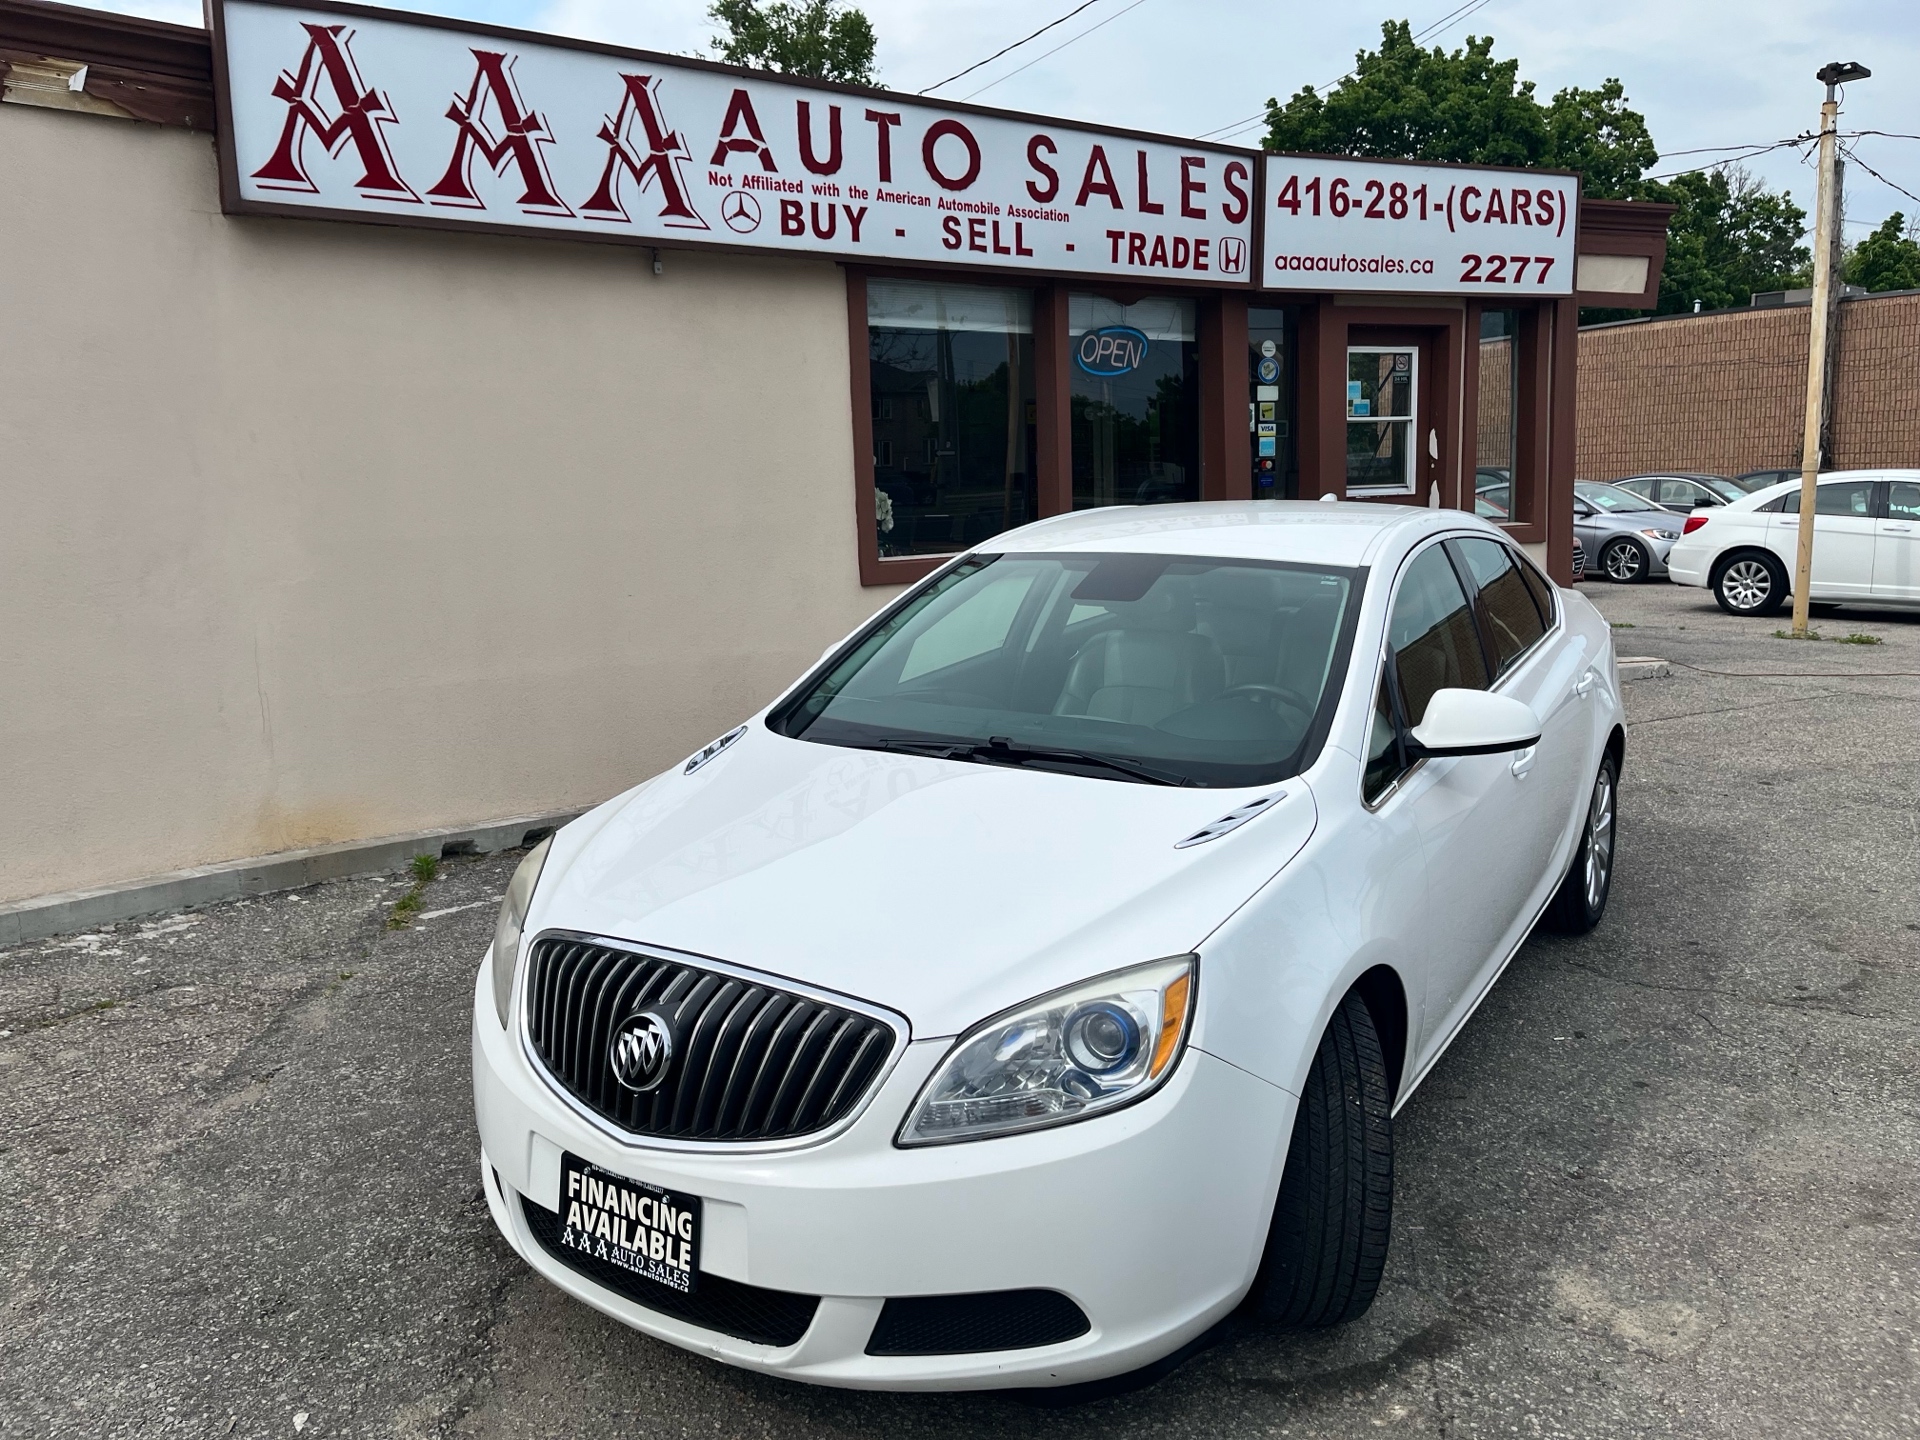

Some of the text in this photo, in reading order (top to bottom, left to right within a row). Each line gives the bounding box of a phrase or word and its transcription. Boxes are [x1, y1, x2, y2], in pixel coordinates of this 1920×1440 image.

[710, 89, 981, 192] AUTO
[1026, 134, 1249, 225] SALES
[708, 171, 1070, 223] Not Affiliated with the American Automobile Association
[1277, 175, 1566, 238] 416-281-(CARS)
[780, 199, 868, 242] BUY
[941, 215, 1033, 257] SELL
[1106, 230, 1210, 271] TRADE
[1275, 254, 1434, 274] aaaautosales.ca
[1459, 254, 1555, 284] 2277
[1081, 335, 1143, 369] OPEN
[568, 1170, 692, 1241] FINANCING
[566, 1201, 691, 1272] AVAILABLE
[611, 1246, 645, 1268] AUTO
[648, 1259, 690, 1287] SALES
